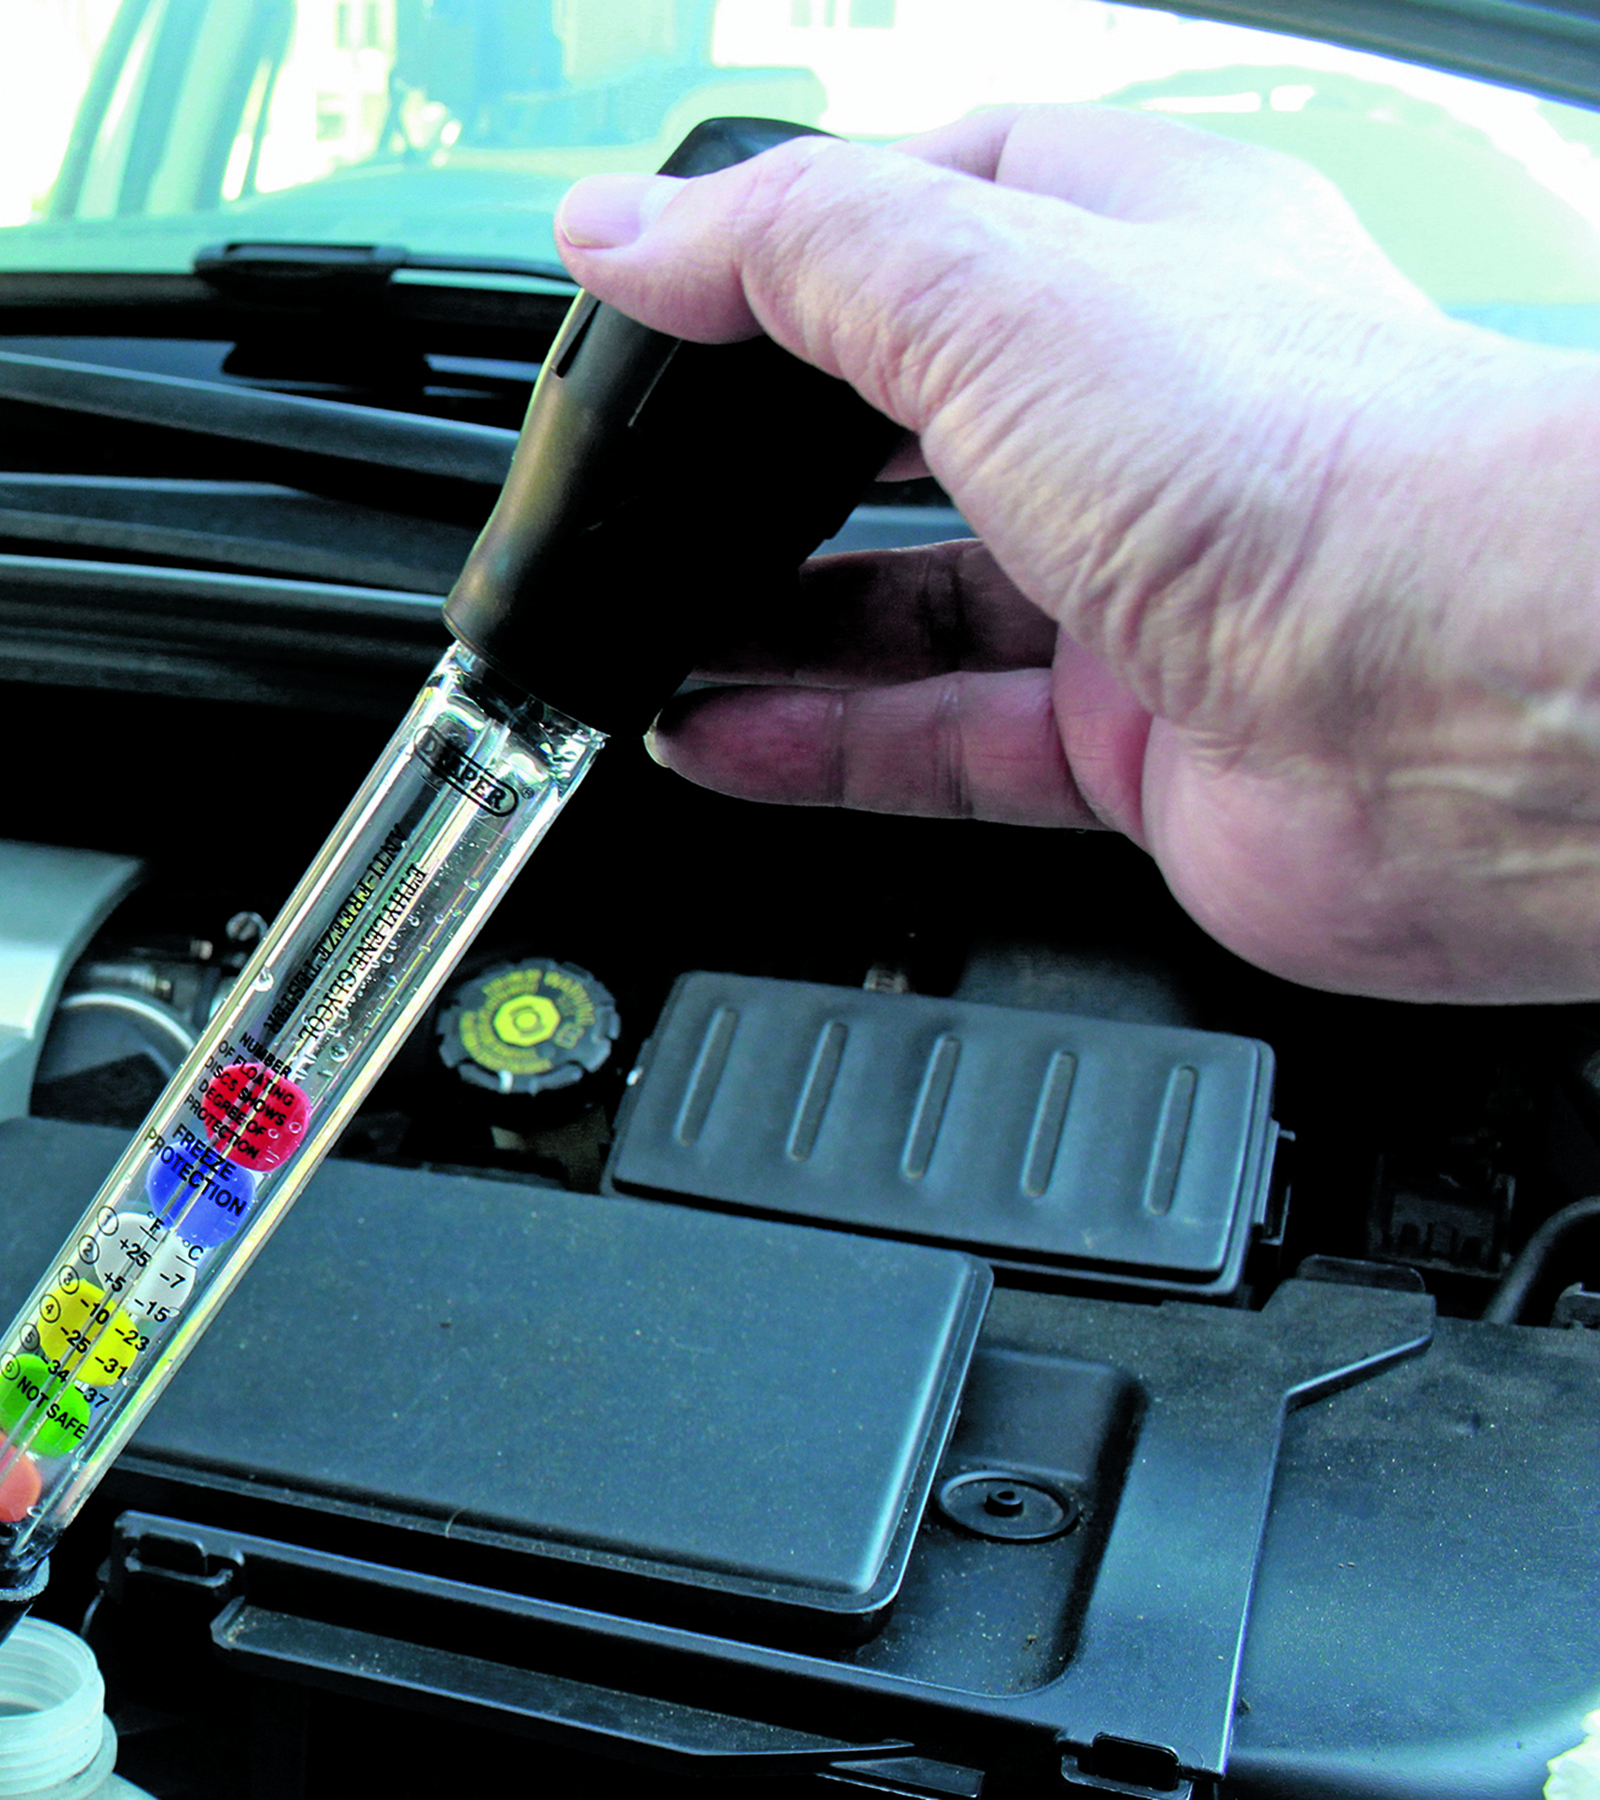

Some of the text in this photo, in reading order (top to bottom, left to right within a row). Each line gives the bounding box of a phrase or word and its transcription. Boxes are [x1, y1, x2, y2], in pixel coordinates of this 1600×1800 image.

[417, 730, 507, 811] DRAPER
[264, 823, 407, 1034] ANTI-FREEZE TESTER
[298, 863, 427, 1040] ETHYLENE GLYCOL
[218, 1040, 295, 1107] OF FLOATING
[239, 1032, 293, 1080] NUMBER
[198, 1079, 268, 1137] DEGREE OF
[204, 1055, 287, 1126] DISCS SHOWS
[172, 1123, 236, 1182] FREEZE
[183, 1094, 260, 1160] PROTECTION
[144, 1126, 248, 1217] PROTECTION
[119, 1238, 152, 1267] +25
[159, 1272, 186, 1289] -7
[80, 1298, 110, 1325] -10
[114, 1326, 150, 1352] -23
[104, 1272, 127, 1293] +5
[134, 1298, 170, 1323] -15
[40, 1356, 70, 1383] -34
[74, 1385, 110, 1409] -37
[60, 1326, 91, 1354] -25
[95, 1356, 128, 1380] -31
[17, 1375, 50, 1408] NOT
[45, 1402, 89, 1440] SAFE
